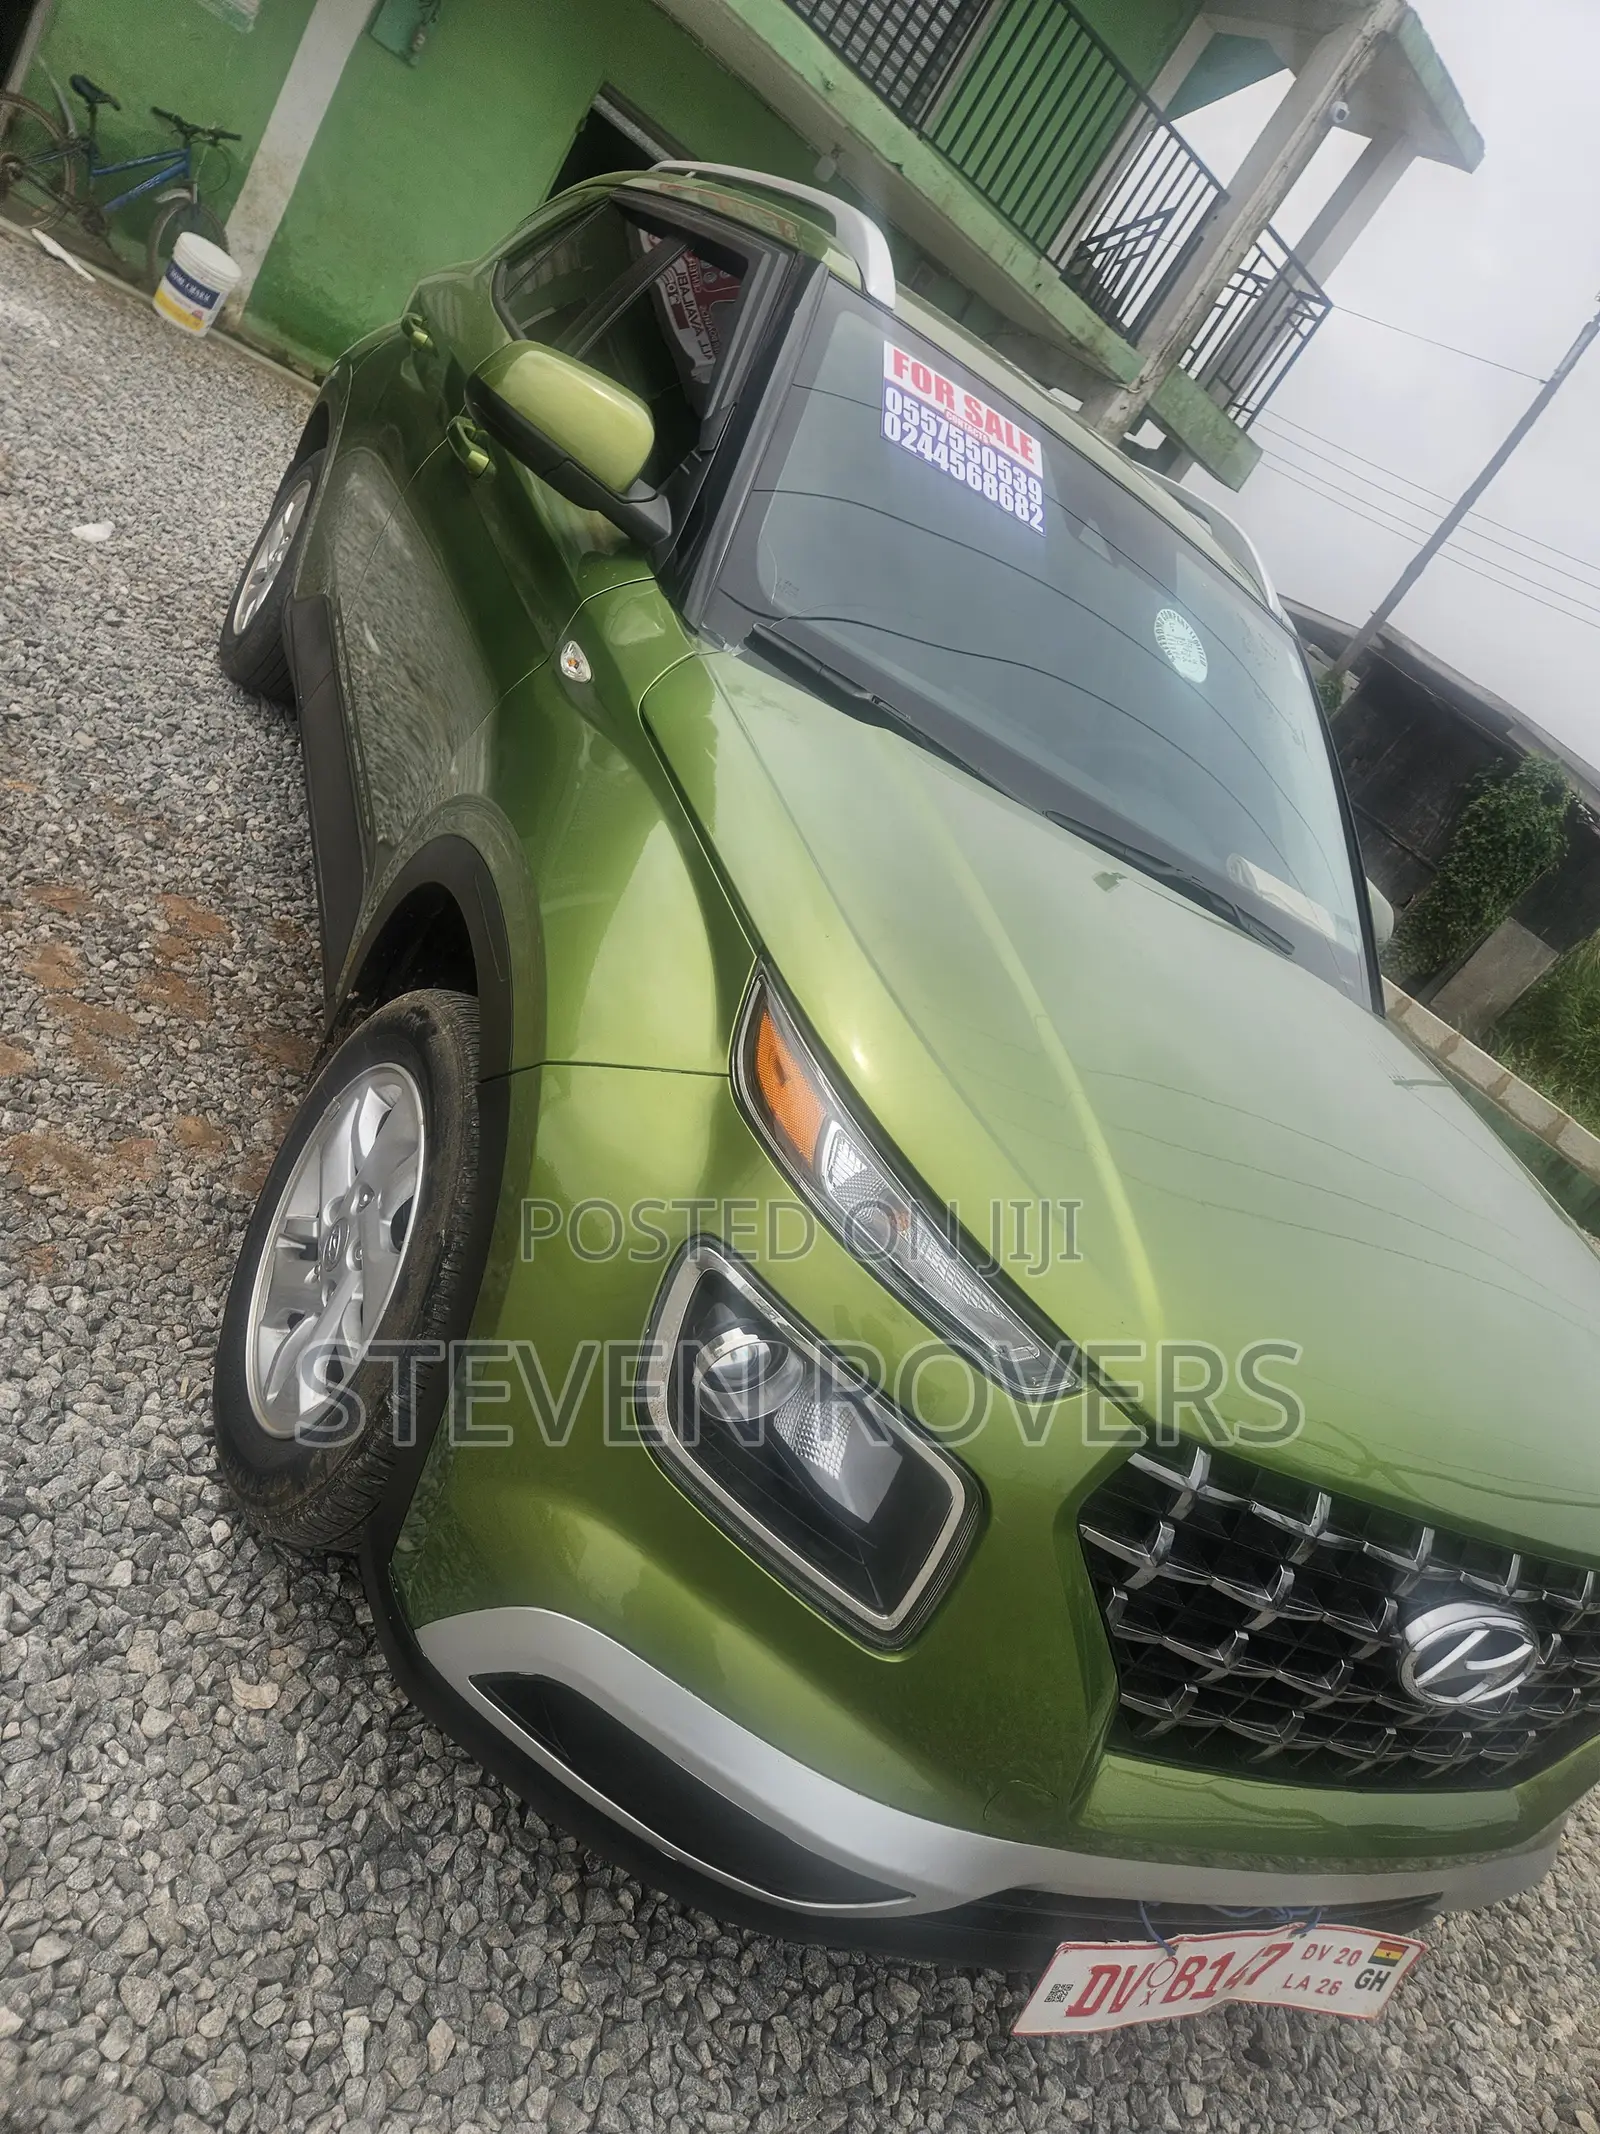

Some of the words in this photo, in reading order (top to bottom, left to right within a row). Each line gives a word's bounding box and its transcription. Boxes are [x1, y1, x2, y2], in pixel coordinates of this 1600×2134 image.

[893, 348, 955, 411] FOR
[964, 394, 1034, 465] SALE
[884, 411, 1044, 533] 0244568682
[885, 386, 1043, 506] 0557550539
[1282, 1973, 1311, 1991] LA
[1315, 1978, 1343, 1996] 26
[1301, 1943, 1334, 1961] DV
[1333, 1947, 1363, 1967] 20
[1354, 1968, 1392, 1993] GH
